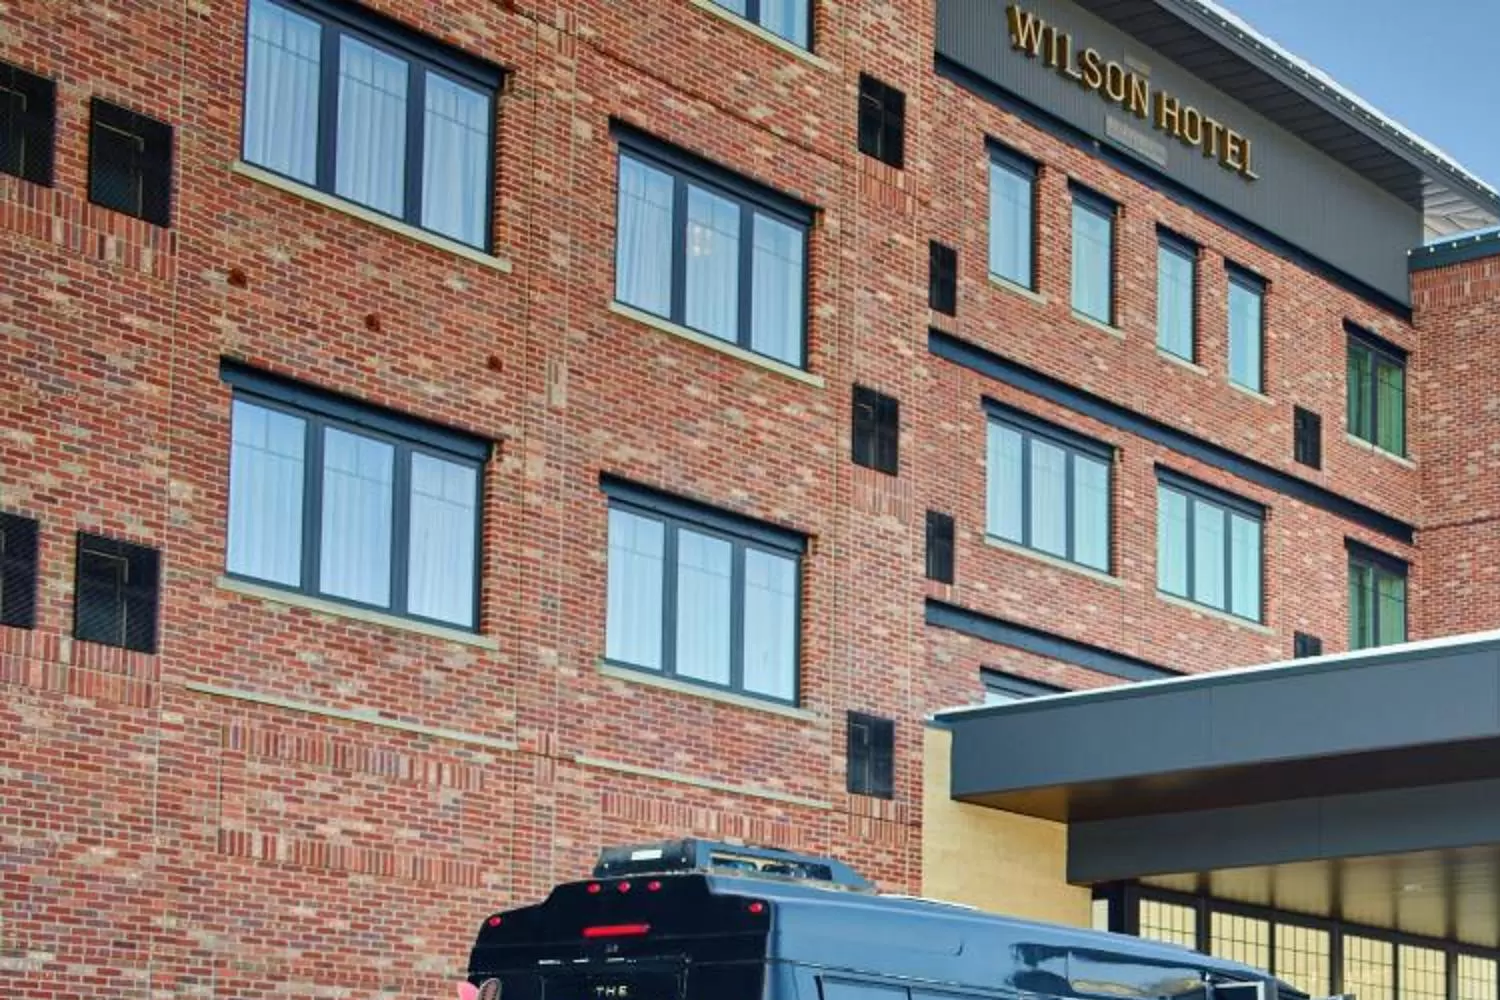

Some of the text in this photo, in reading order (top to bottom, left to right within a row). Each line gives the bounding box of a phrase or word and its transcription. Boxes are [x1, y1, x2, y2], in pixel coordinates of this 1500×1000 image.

[1007, 5, 1259, 180] WILSON HOTEL
[596, 985, 628, 997] THE
